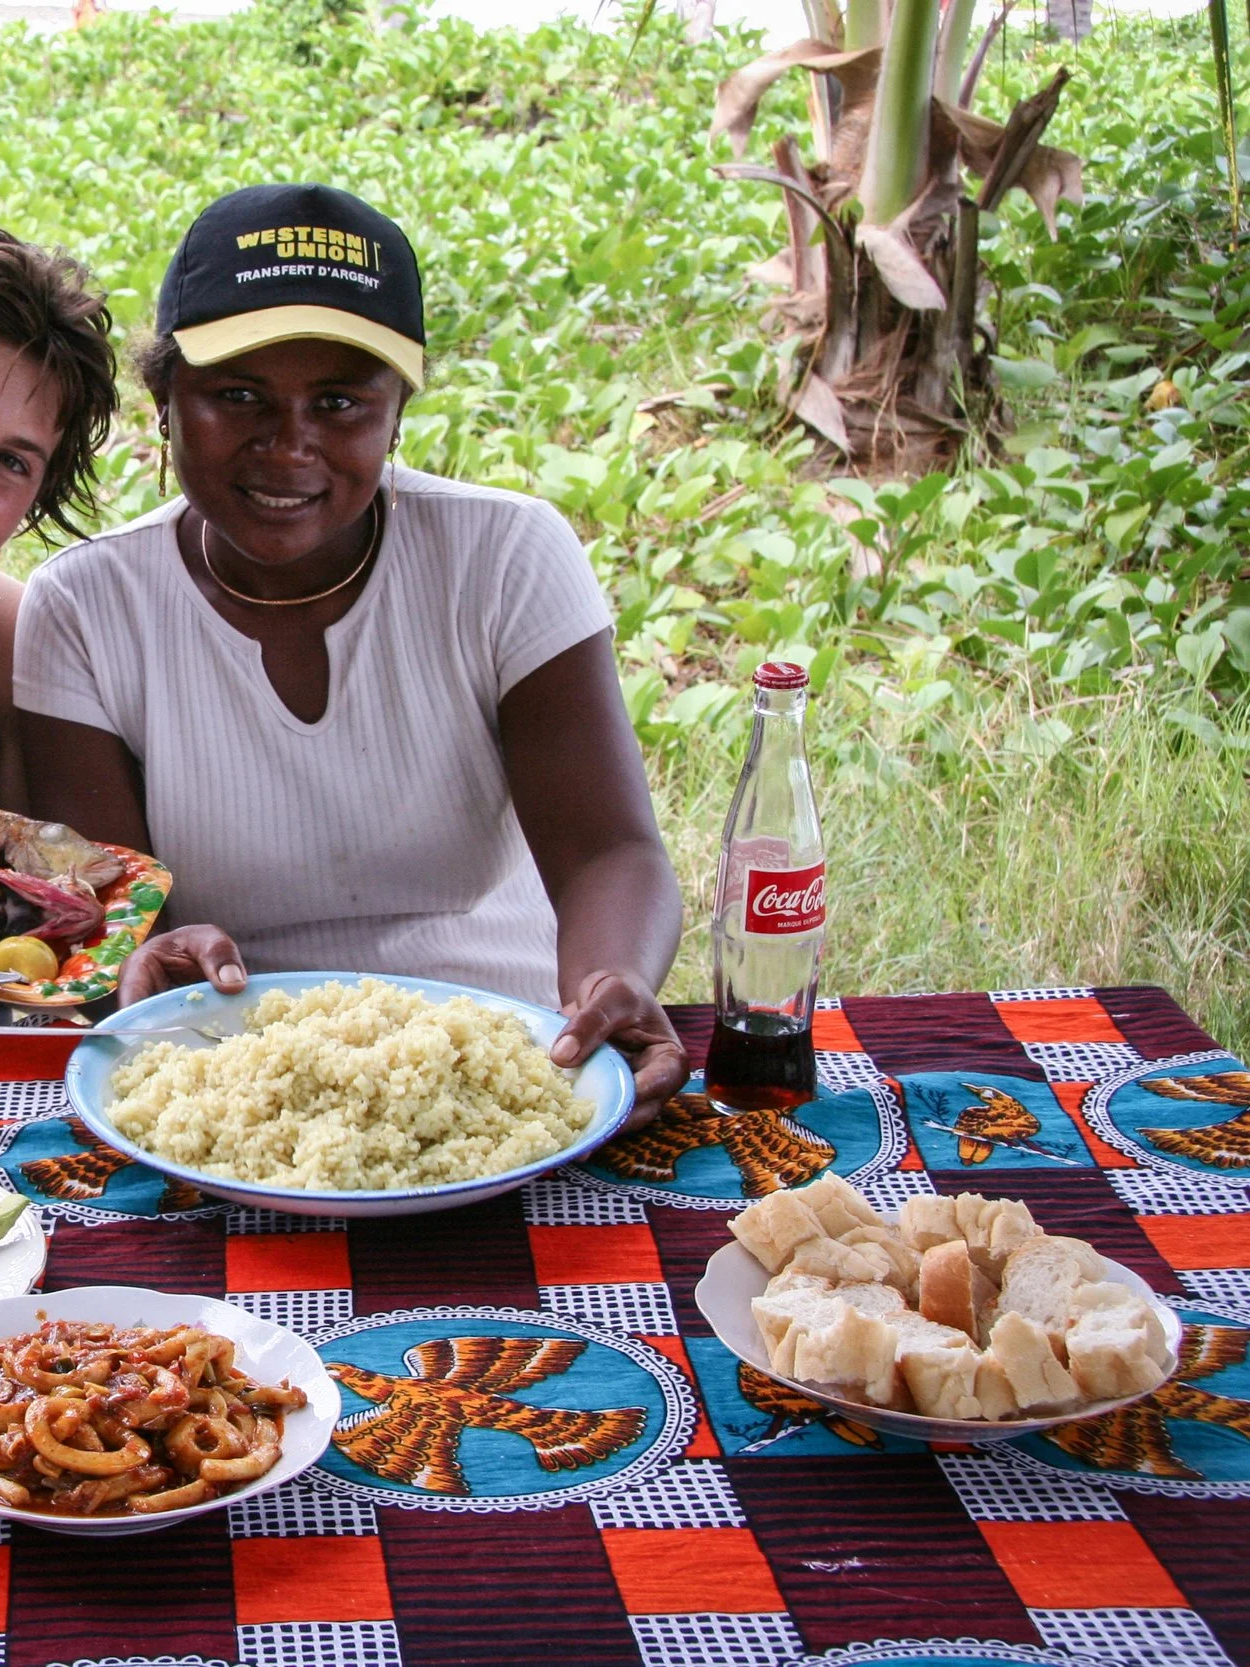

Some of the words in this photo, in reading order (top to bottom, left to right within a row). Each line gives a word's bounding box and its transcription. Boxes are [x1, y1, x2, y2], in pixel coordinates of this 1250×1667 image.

[236, 226, 365, 250] WESTERN
[276, 242, 364, 267] UNION
[235, 264, 315, 284] TRANSFERT
[317, 266, 380, 289] D'ARGENT
